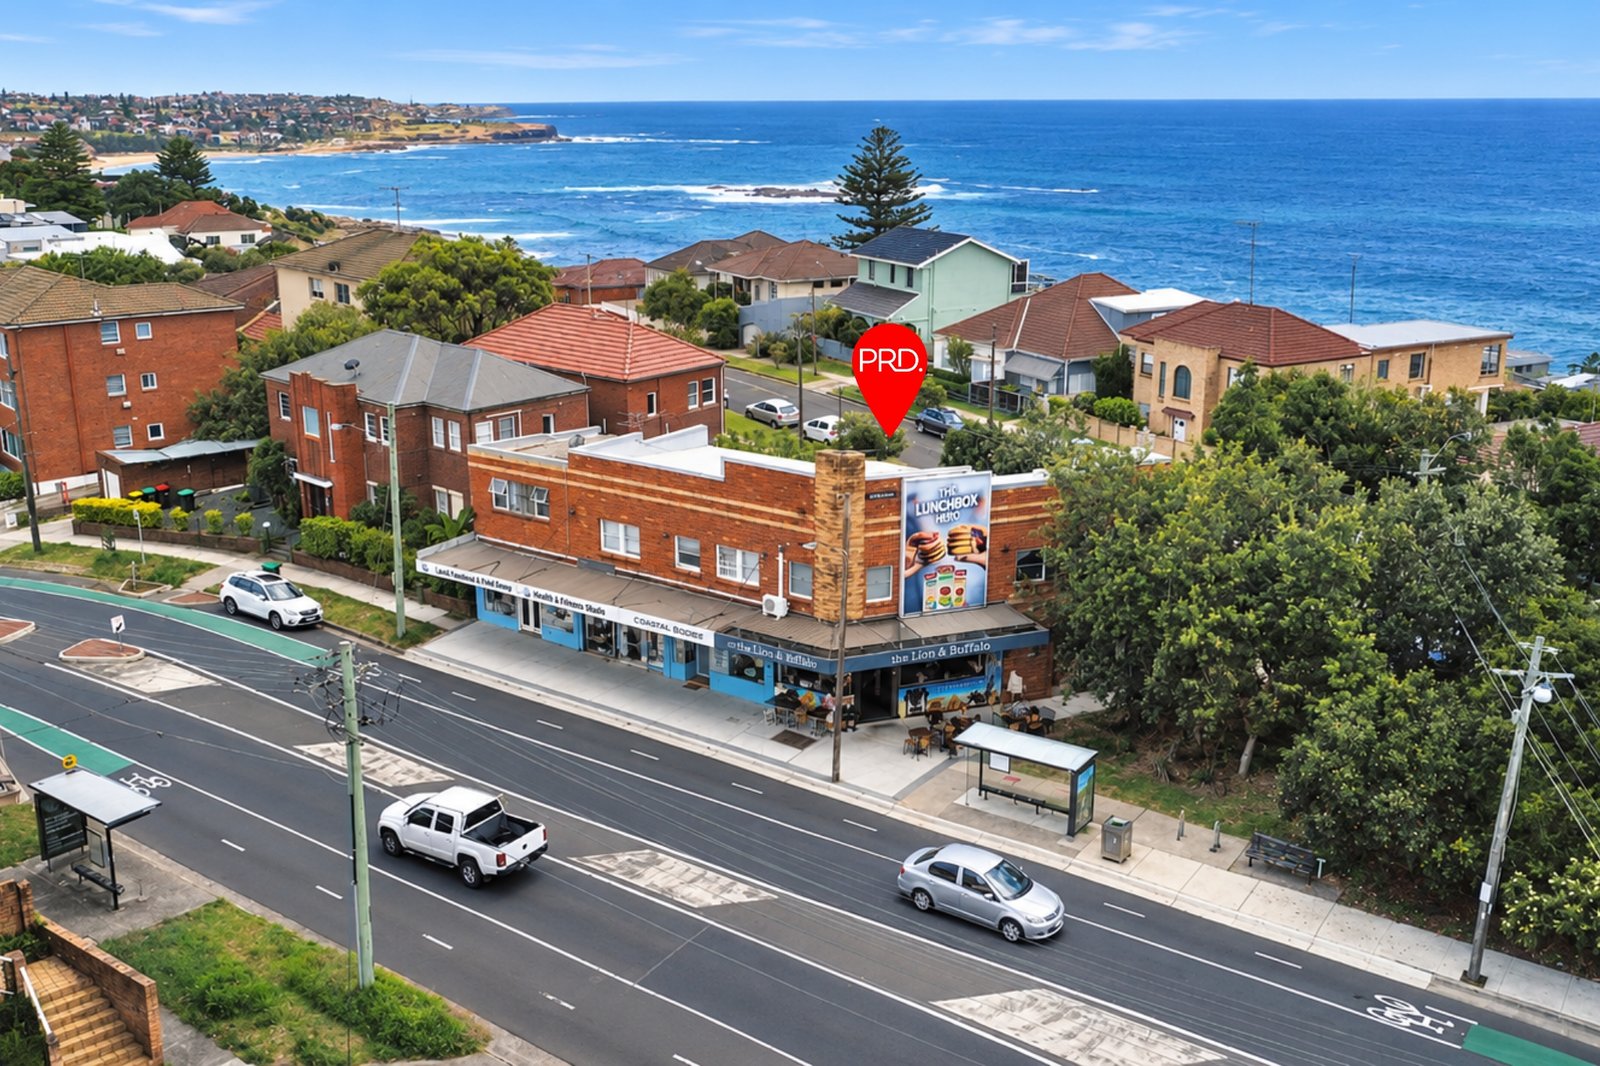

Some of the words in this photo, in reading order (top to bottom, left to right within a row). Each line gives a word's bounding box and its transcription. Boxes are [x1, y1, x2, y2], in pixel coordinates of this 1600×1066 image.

[915, 493, 979, 517] LUNCHBOX
[633, 616, 671, 632] COASTAL
[736, 642, 751, 652] the
[753, 644, 774, 659] Lion
[891, 654, 909, 664] the
[911, 649, 936, 661] Lion
[938, 647, 946, 657] &
[949, 641, 991, 655] Buffalo
